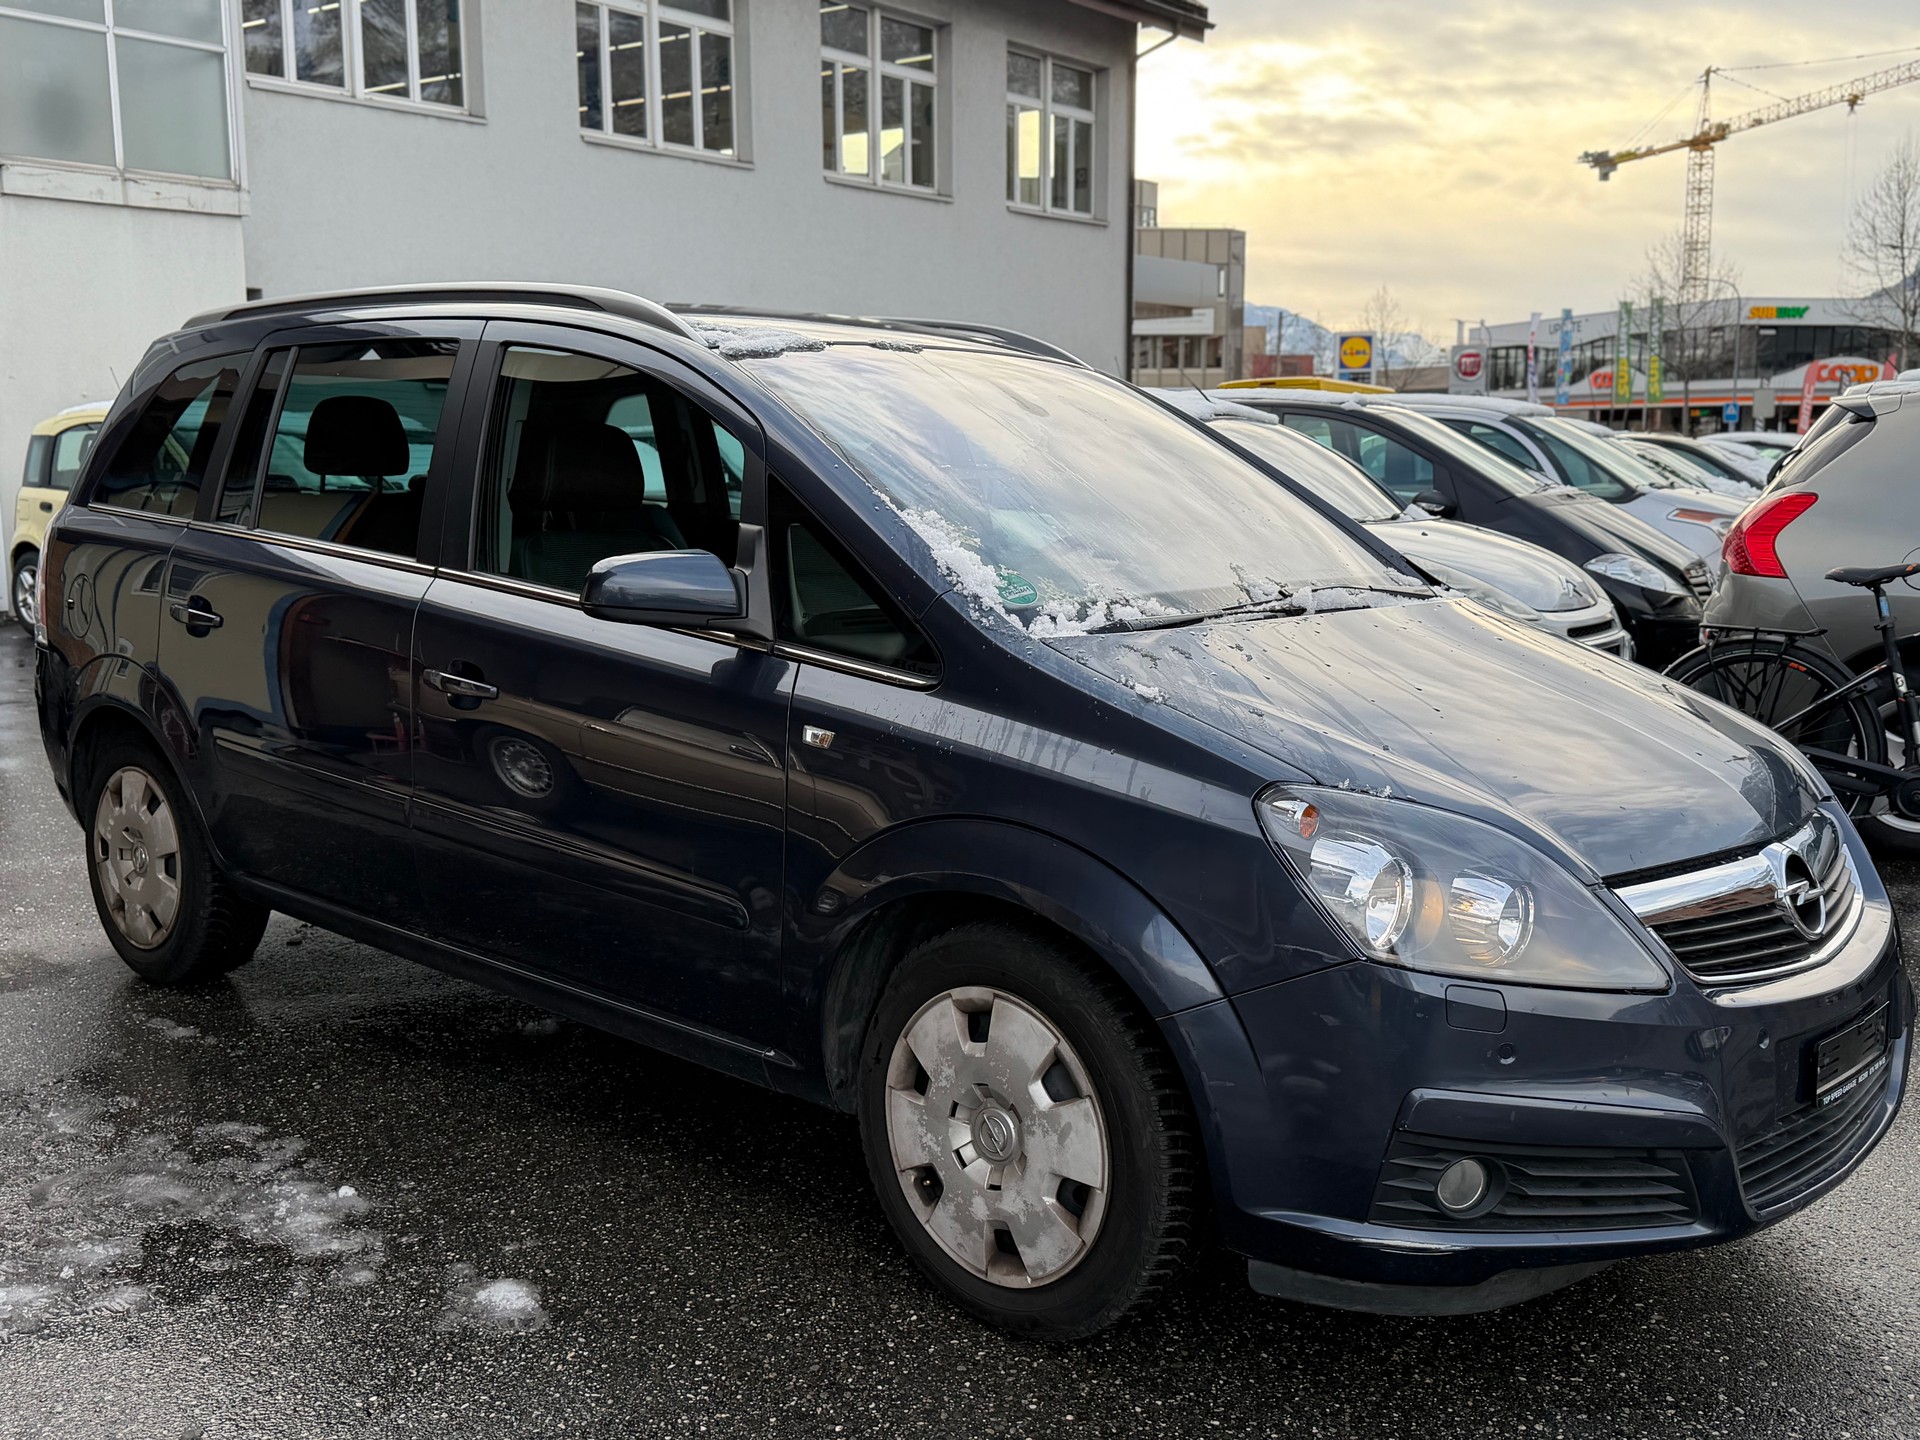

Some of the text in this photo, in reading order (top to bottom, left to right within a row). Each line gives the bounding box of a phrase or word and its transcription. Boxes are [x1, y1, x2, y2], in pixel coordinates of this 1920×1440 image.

[1747, 304, 1810, 320] SUBWAY
[1823, 1095, 1831, 1106] TOP
[1831, 1088, 1843, 1101] SPEED
